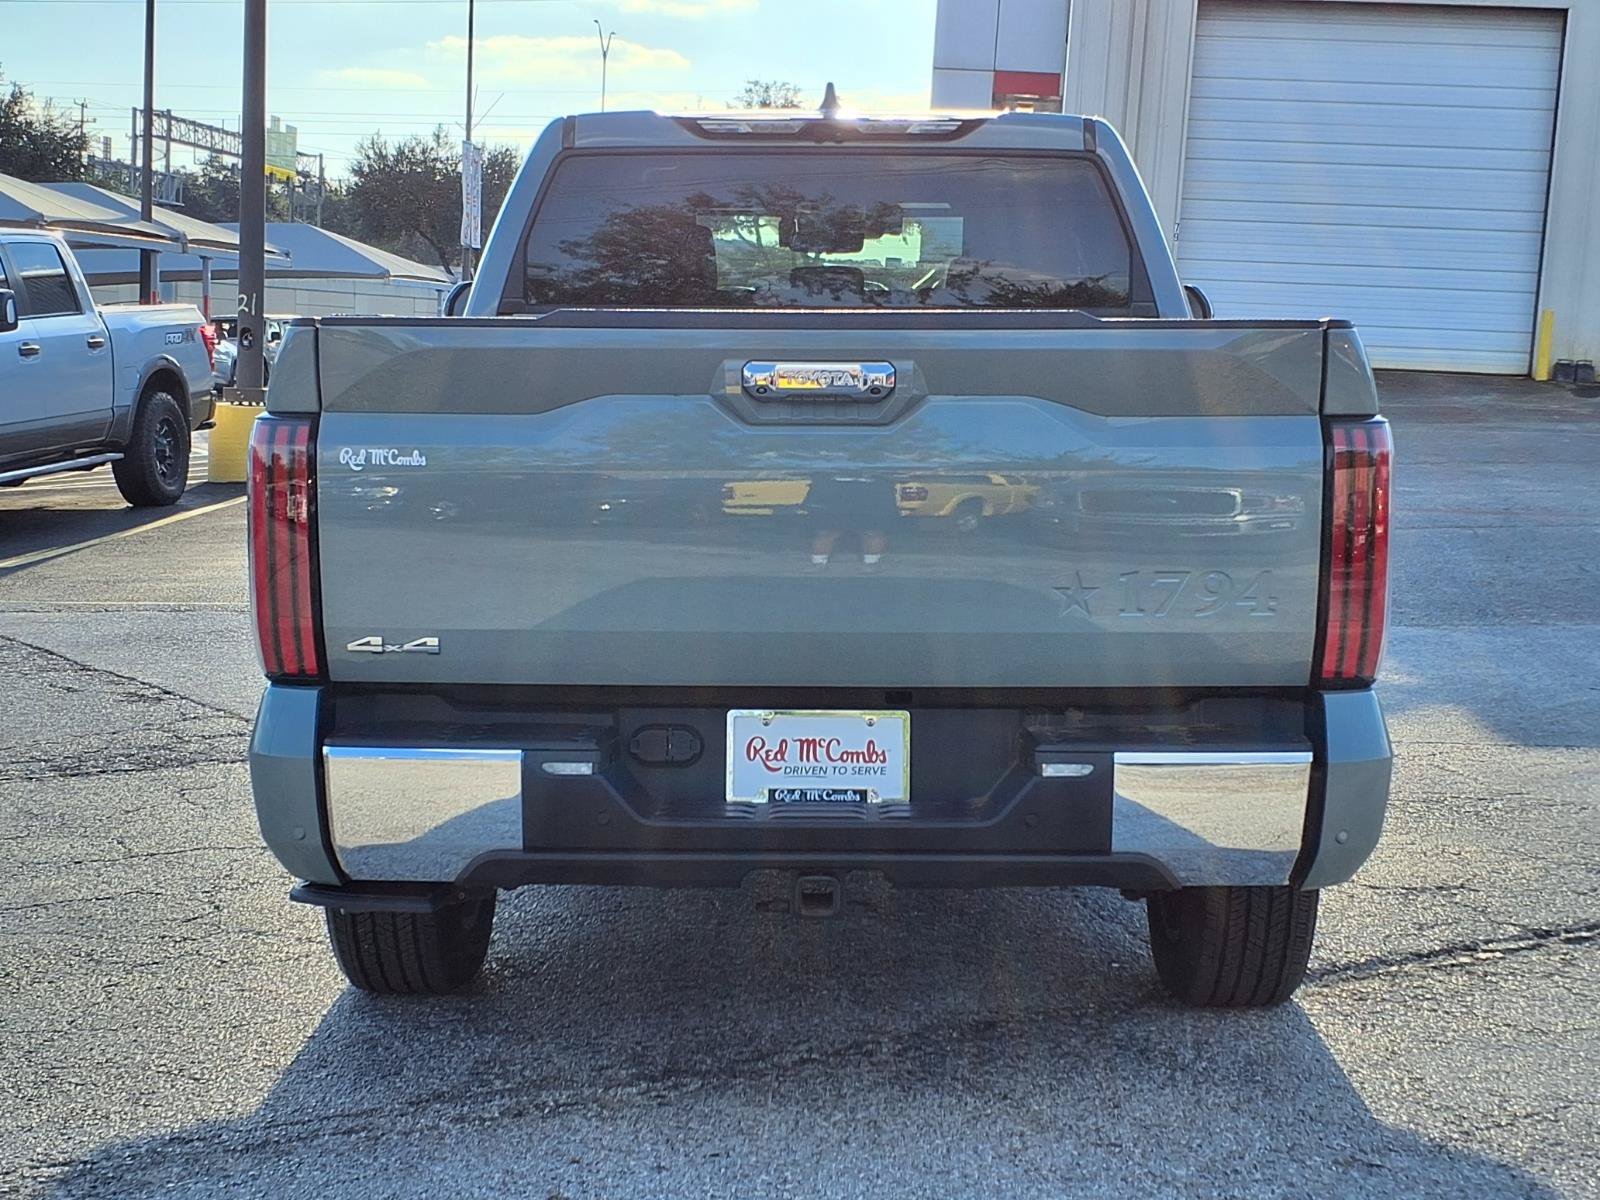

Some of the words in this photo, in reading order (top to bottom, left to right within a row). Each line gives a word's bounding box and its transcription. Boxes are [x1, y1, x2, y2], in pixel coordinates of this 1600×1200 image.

[238, 293, 256, 316] 21
[784, 371, 853, 386] TOYOTA
[340, 447, 366, 471] Red
[1118, 570, 1278, 617] 1794
[746, 736, 788, 773] Red
[784, 766, 828, 775] DRIVEN
[832, 766, 848, 775] TO
[851, 766, 887, 776] SERVE
